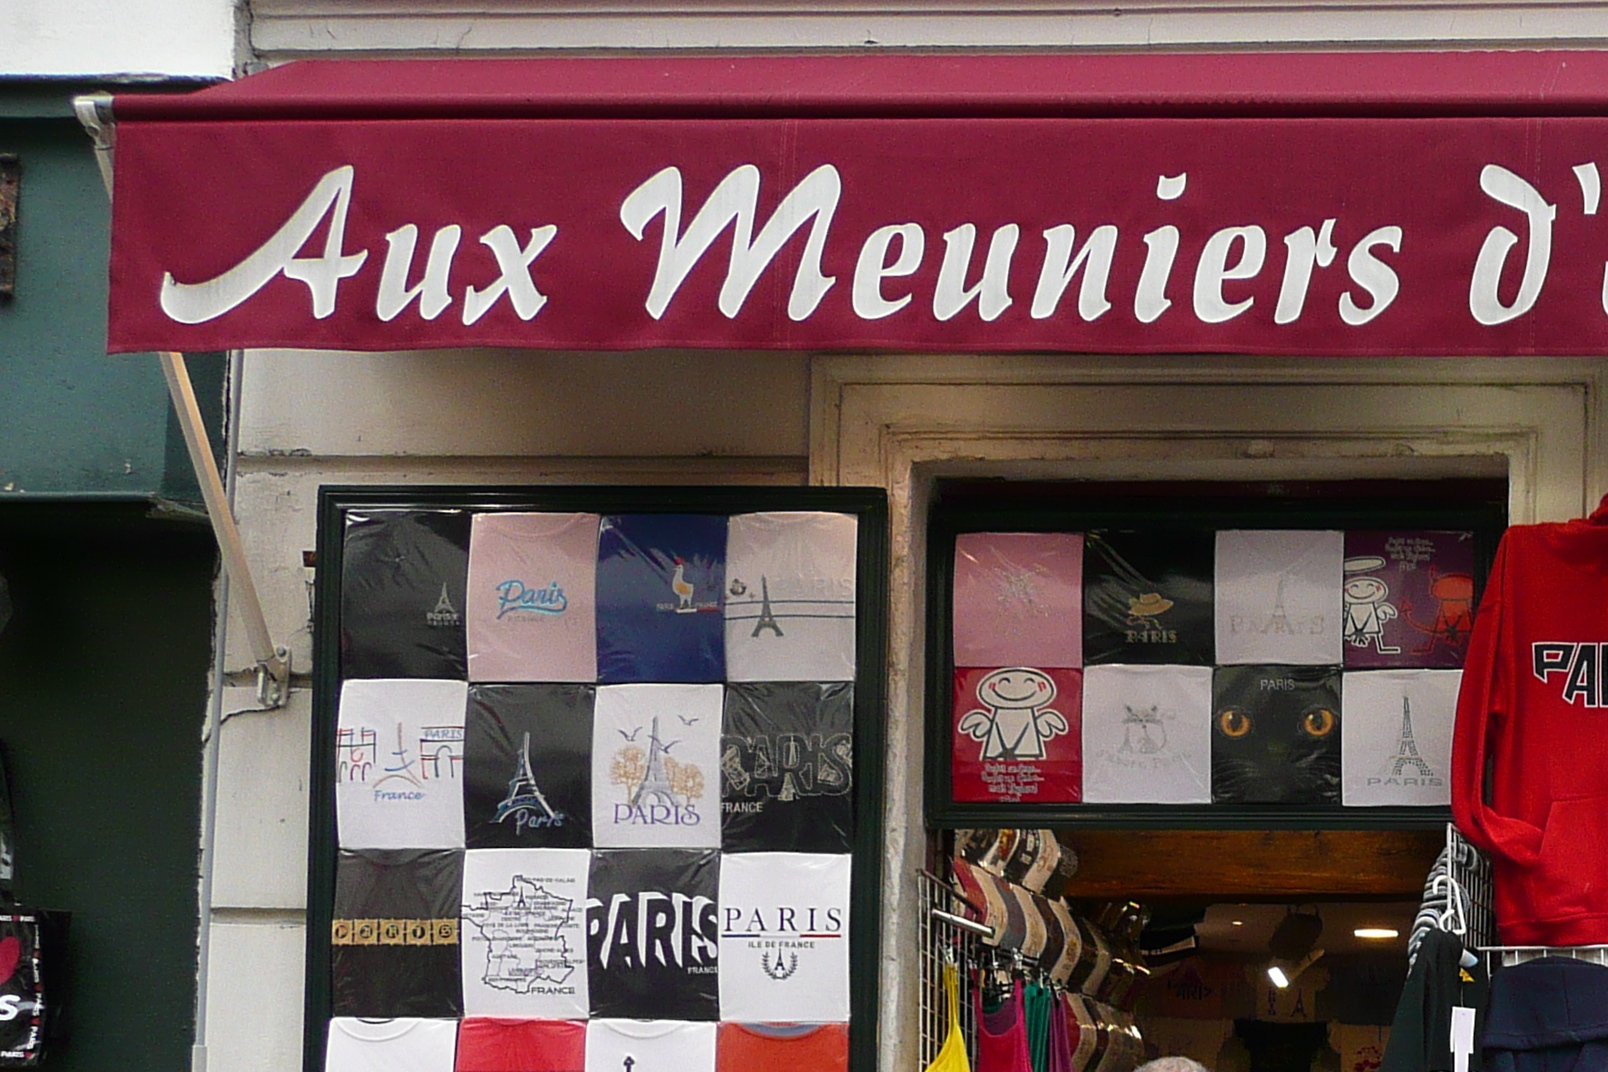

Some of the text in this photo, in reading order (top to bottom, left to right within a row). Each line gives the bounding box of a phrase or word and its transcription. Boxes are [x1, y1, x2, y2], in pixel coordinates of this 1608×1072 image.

[160, 163, 557, 326] Aux
[620, 162, 1403, 328] Meuniers
[495, 579, 568, 618] Paris
[1126, 629, 1178, 644] PARIS
[1259, 678, 1296, 692] PARIS
[720, 734, 853, 801] PARIS
[1366, 774, 1444, 787] PARIS
[374, 788, 426, 803] France
[612, 802, 701, 826] PARIS
[722, 906, 843, 934] PARIS
[748, 940, 816, 950] ILE DE FRANCE
[530, 986, 576, 995] FRANCE
